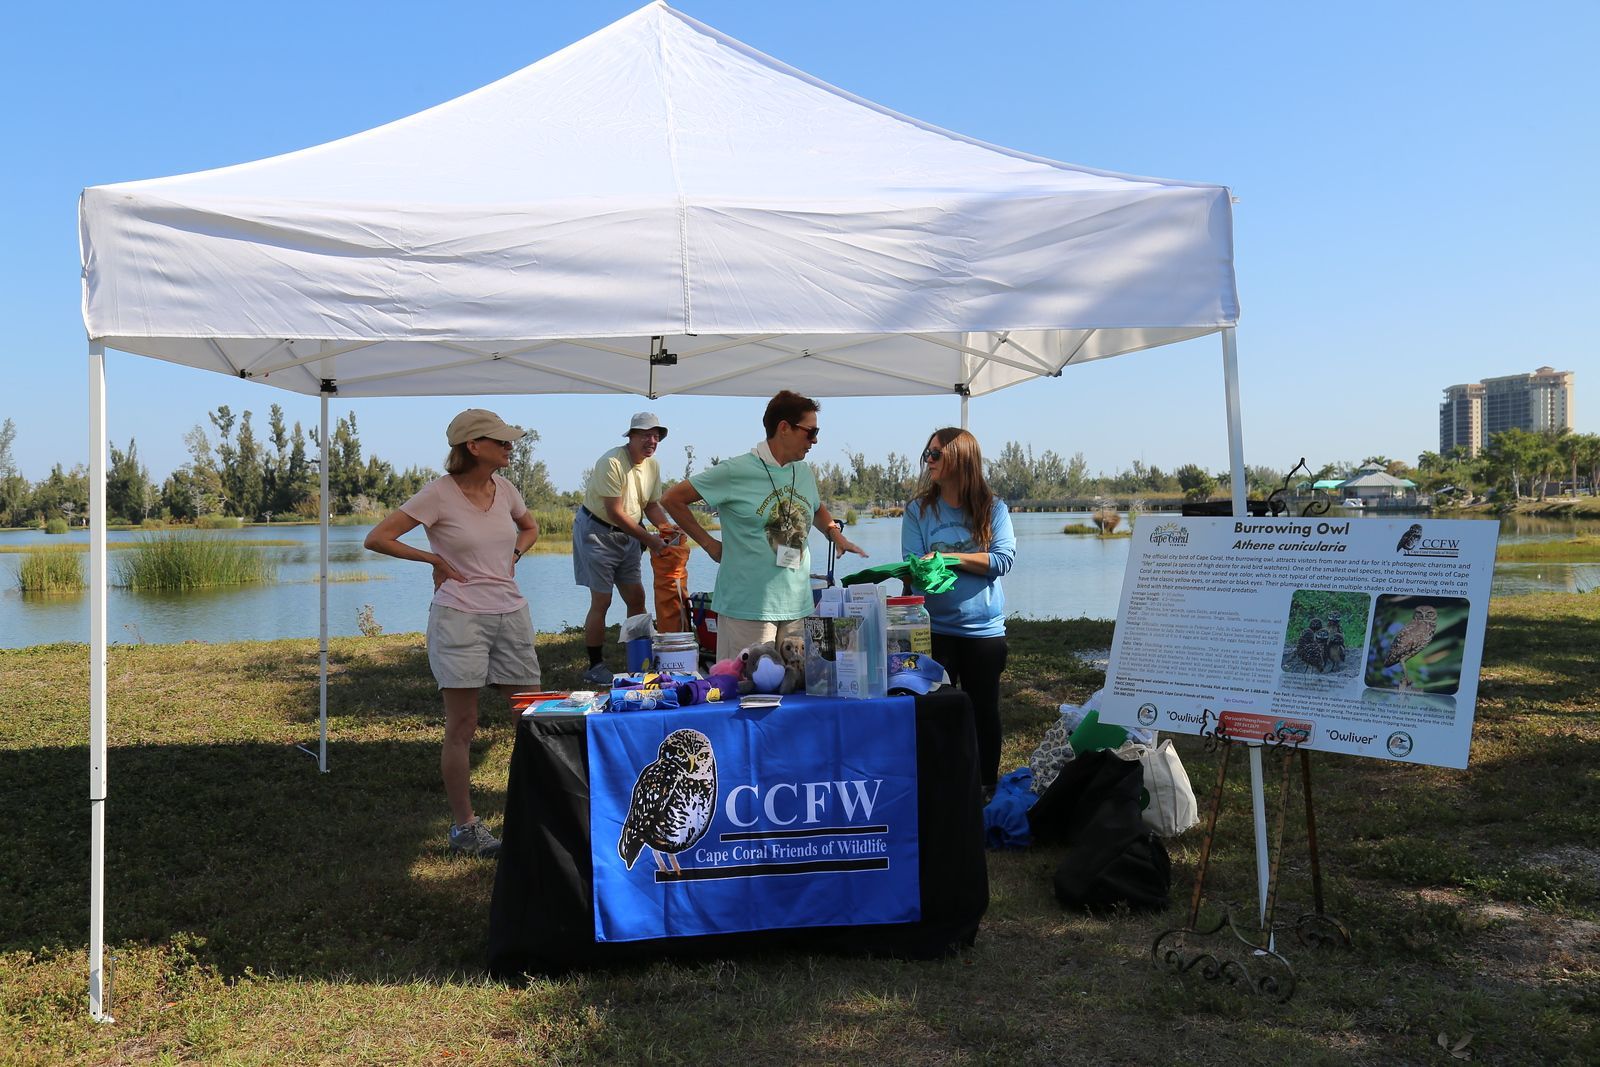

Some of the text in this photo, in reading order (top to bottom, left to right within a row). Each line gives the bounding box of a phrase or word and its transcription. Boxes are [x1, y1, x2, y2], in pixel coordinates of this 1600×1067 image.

[1234, 522, 1350, 537] Burrowing Owl
[1150, 532, 1189, 546] Cape Coral
[1232, 540, 1347, 552] Athene cunicularia
[1422, 539, 1459, 548] CCFW
[1405, 579, 1438, 587] burrowing
[1326, 729, 1377, 744] "Owliver"
[725, 780, 883, 827] CCFW
[696, 838, 886, 864] Cape Coral Friends of Wildlife
